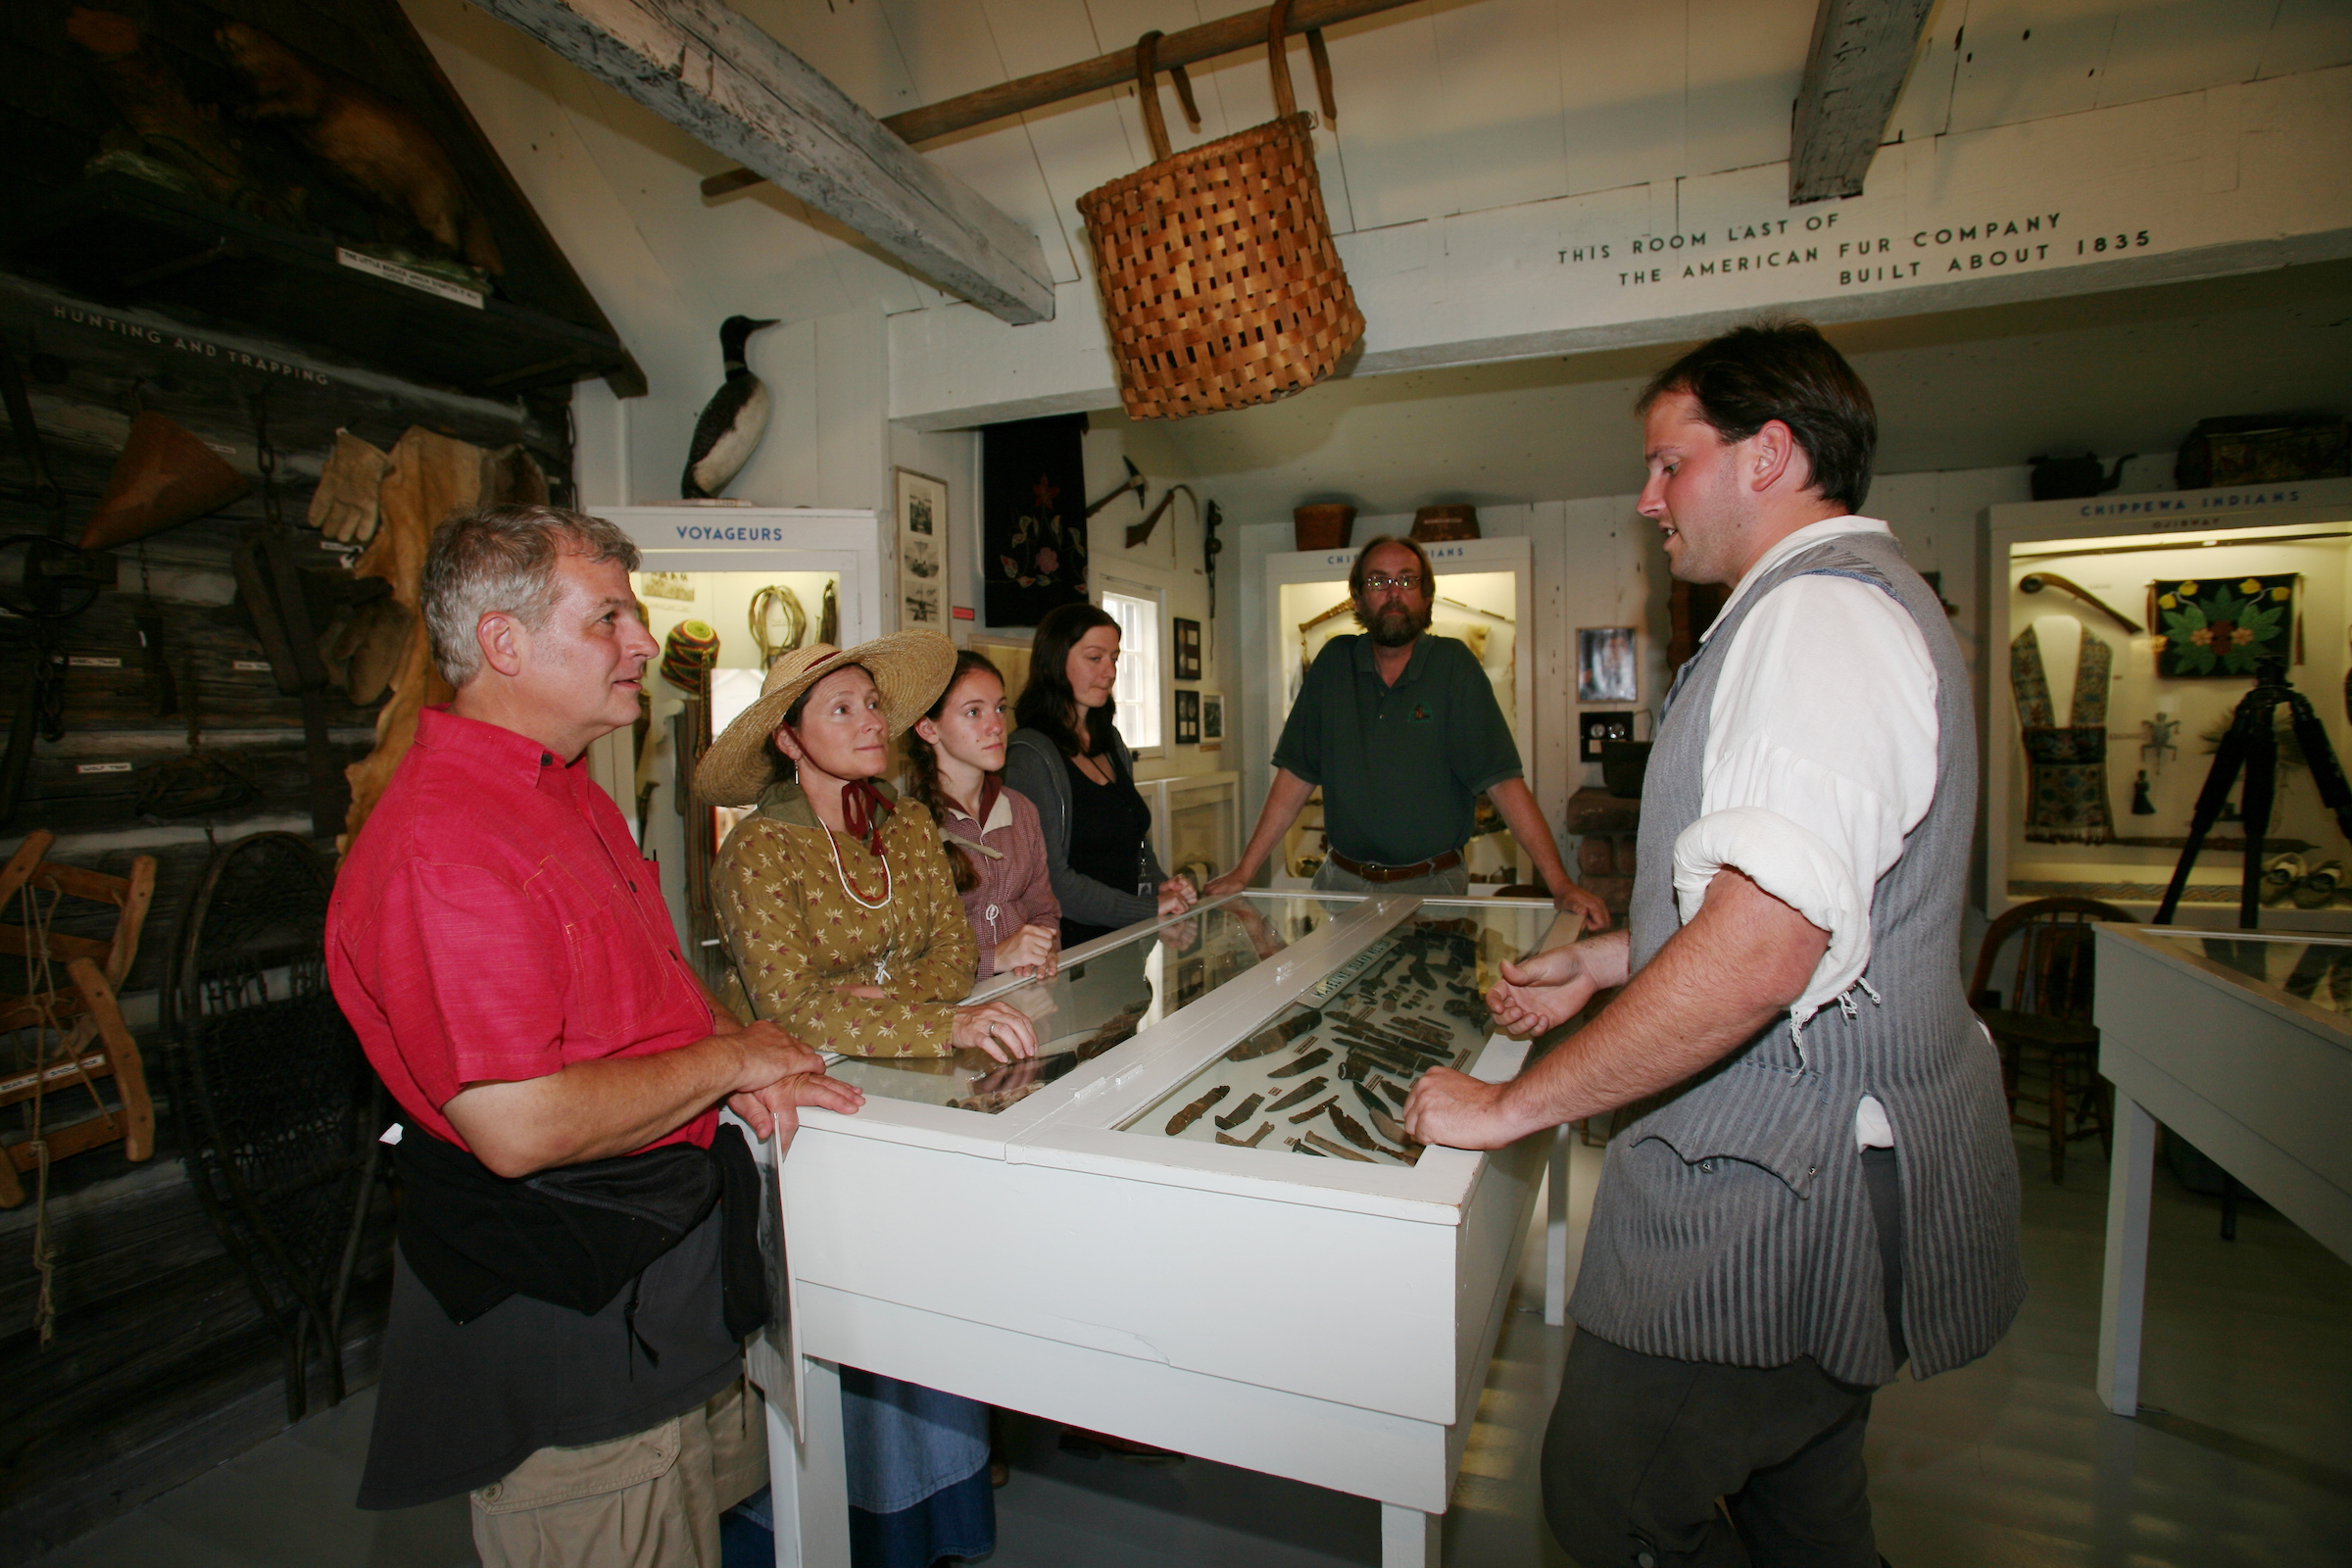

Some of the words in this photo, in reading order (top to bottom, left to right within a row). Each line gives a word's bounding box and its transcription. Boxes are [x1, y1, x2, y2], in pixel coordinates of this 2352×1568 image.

[1556, 243, 1612, 265] THIS
[1632, 230, 1708, 254] ROOM
[1728, 219, 1791, 241] LAST
[1805, 212, 1841, 232] OF
[1618, 268, 1662, 287] THE
[1682, 246, 1820, 279] AMERICAN
[1839, 238, 1892, 259] FUR
[1912, 212, 2063, 247] COMPANY
[1839, 261, 1923, 286] BUILT
[1947, 243, 2050, 273] ABOUT
[2077, 229, 2151, 256] 1835
[53, 305, 162, 345] HUNTING
[172, 337, 218, 359] AND
[227, 350, 329, 386] TRAPPING
[2080, 500, 2185, 517] CHIPPEWA
[2202, 490, 2300, 509] INDIANS
[675, 525, 783, 541] VOYAGEURS
[1347, 955, 1372, 972] ISLAND
